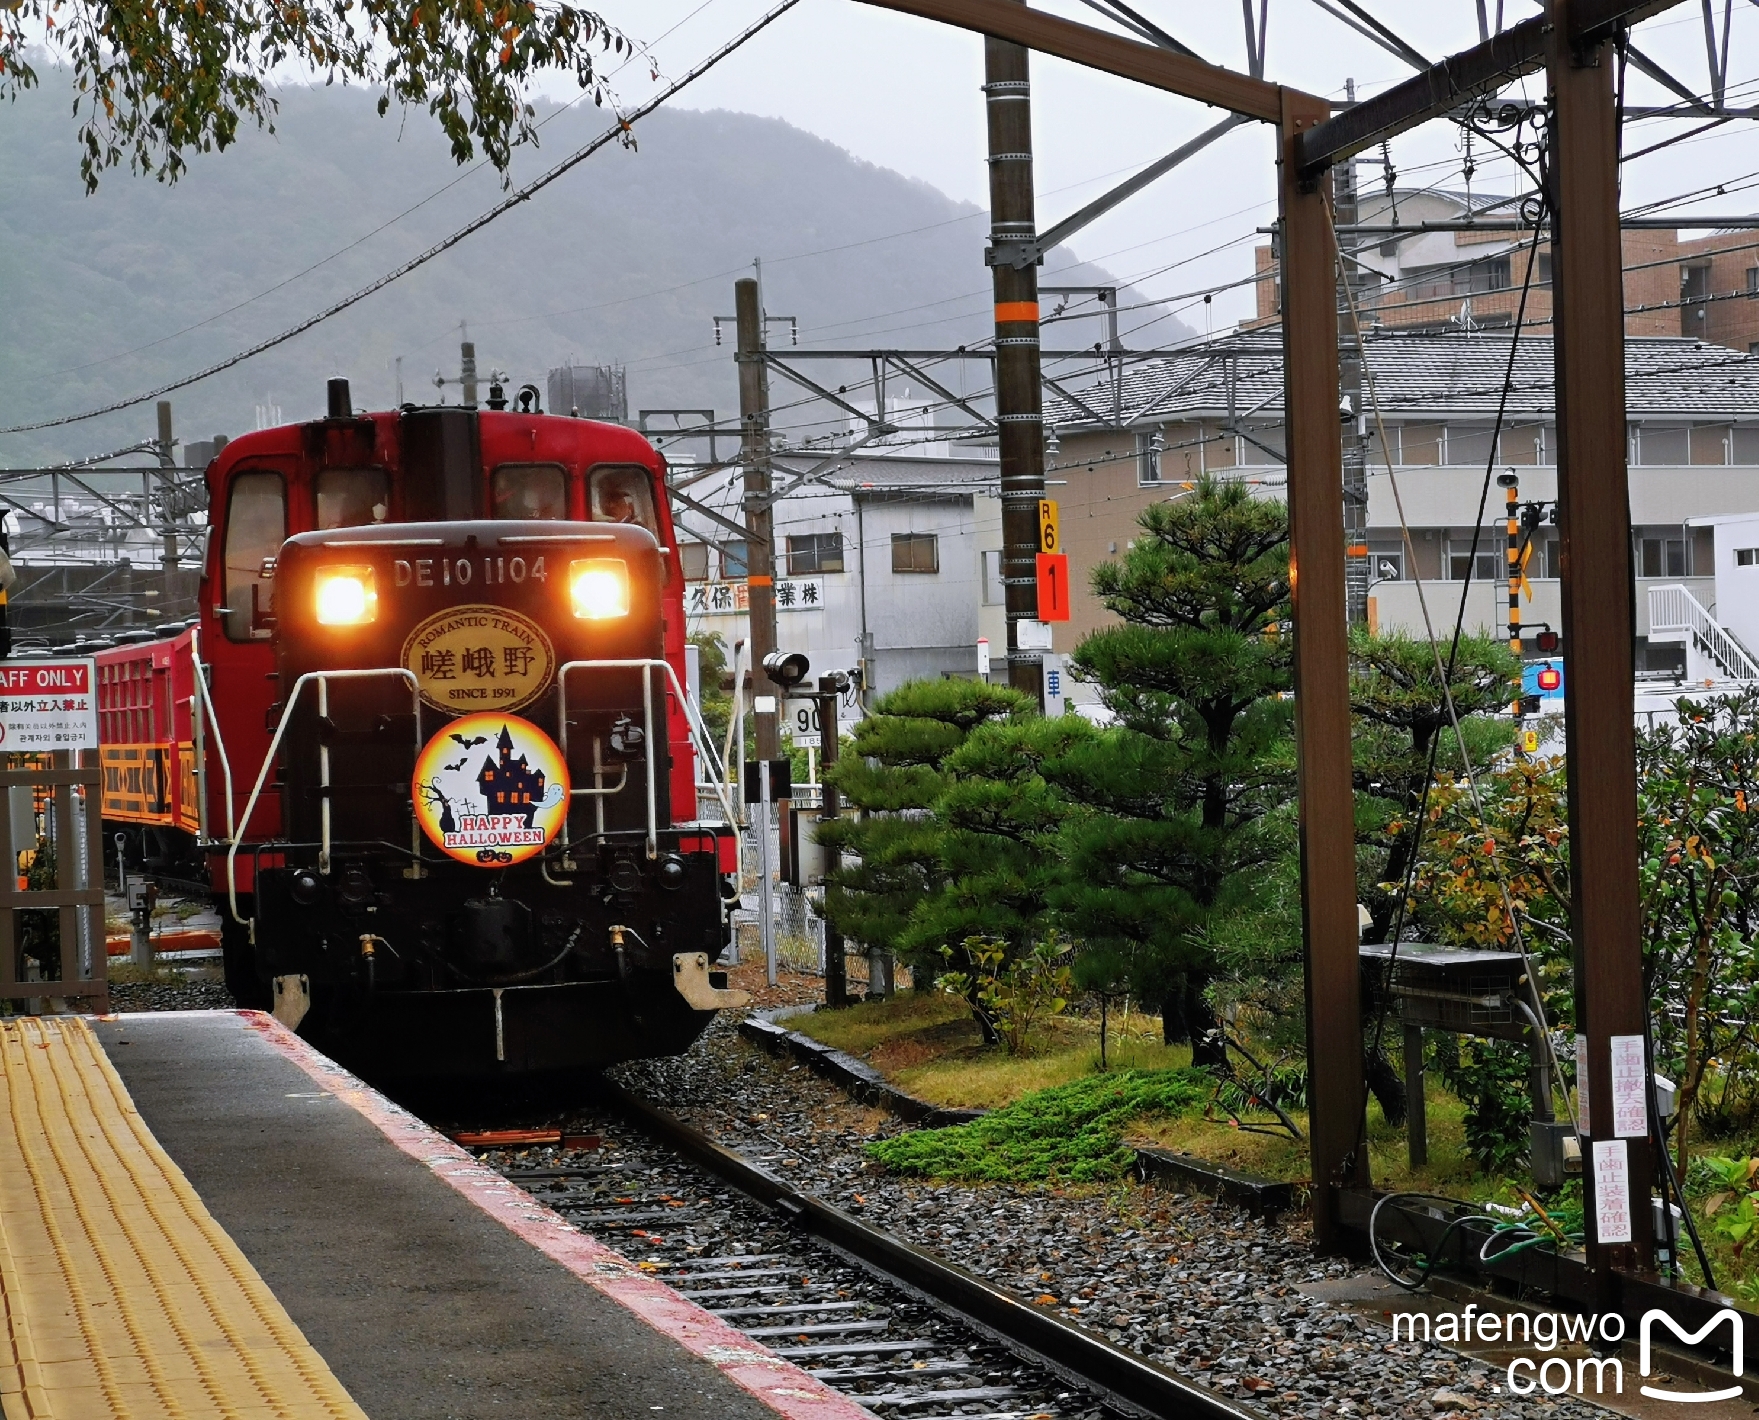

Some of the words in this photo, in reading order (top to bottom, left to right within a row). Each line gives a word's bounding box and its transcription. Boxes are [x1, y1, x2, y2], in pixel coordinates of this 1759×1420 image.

[1042, 503, 1051, 520] R
[1044, 523, 1055, 550] 6
[484, 556, 548, 585] 1104
[1048, 563, 1058, 611] 1
[417, 616, 488, 649] ROMANTIC
[491, 618, 535, 646] TRAIN
[421, 646, 536, 680] 嵯峨野
[36, 669, 83, 687] ONLY
[1047, 669, 1061, 699] 車
[448, 688, 488, 699] SINCE
[492, 688, 516, 699] 1991
[462, 815, 526, 832] HAPPY
[447, 830, 542, 846] HALLOWEEN
